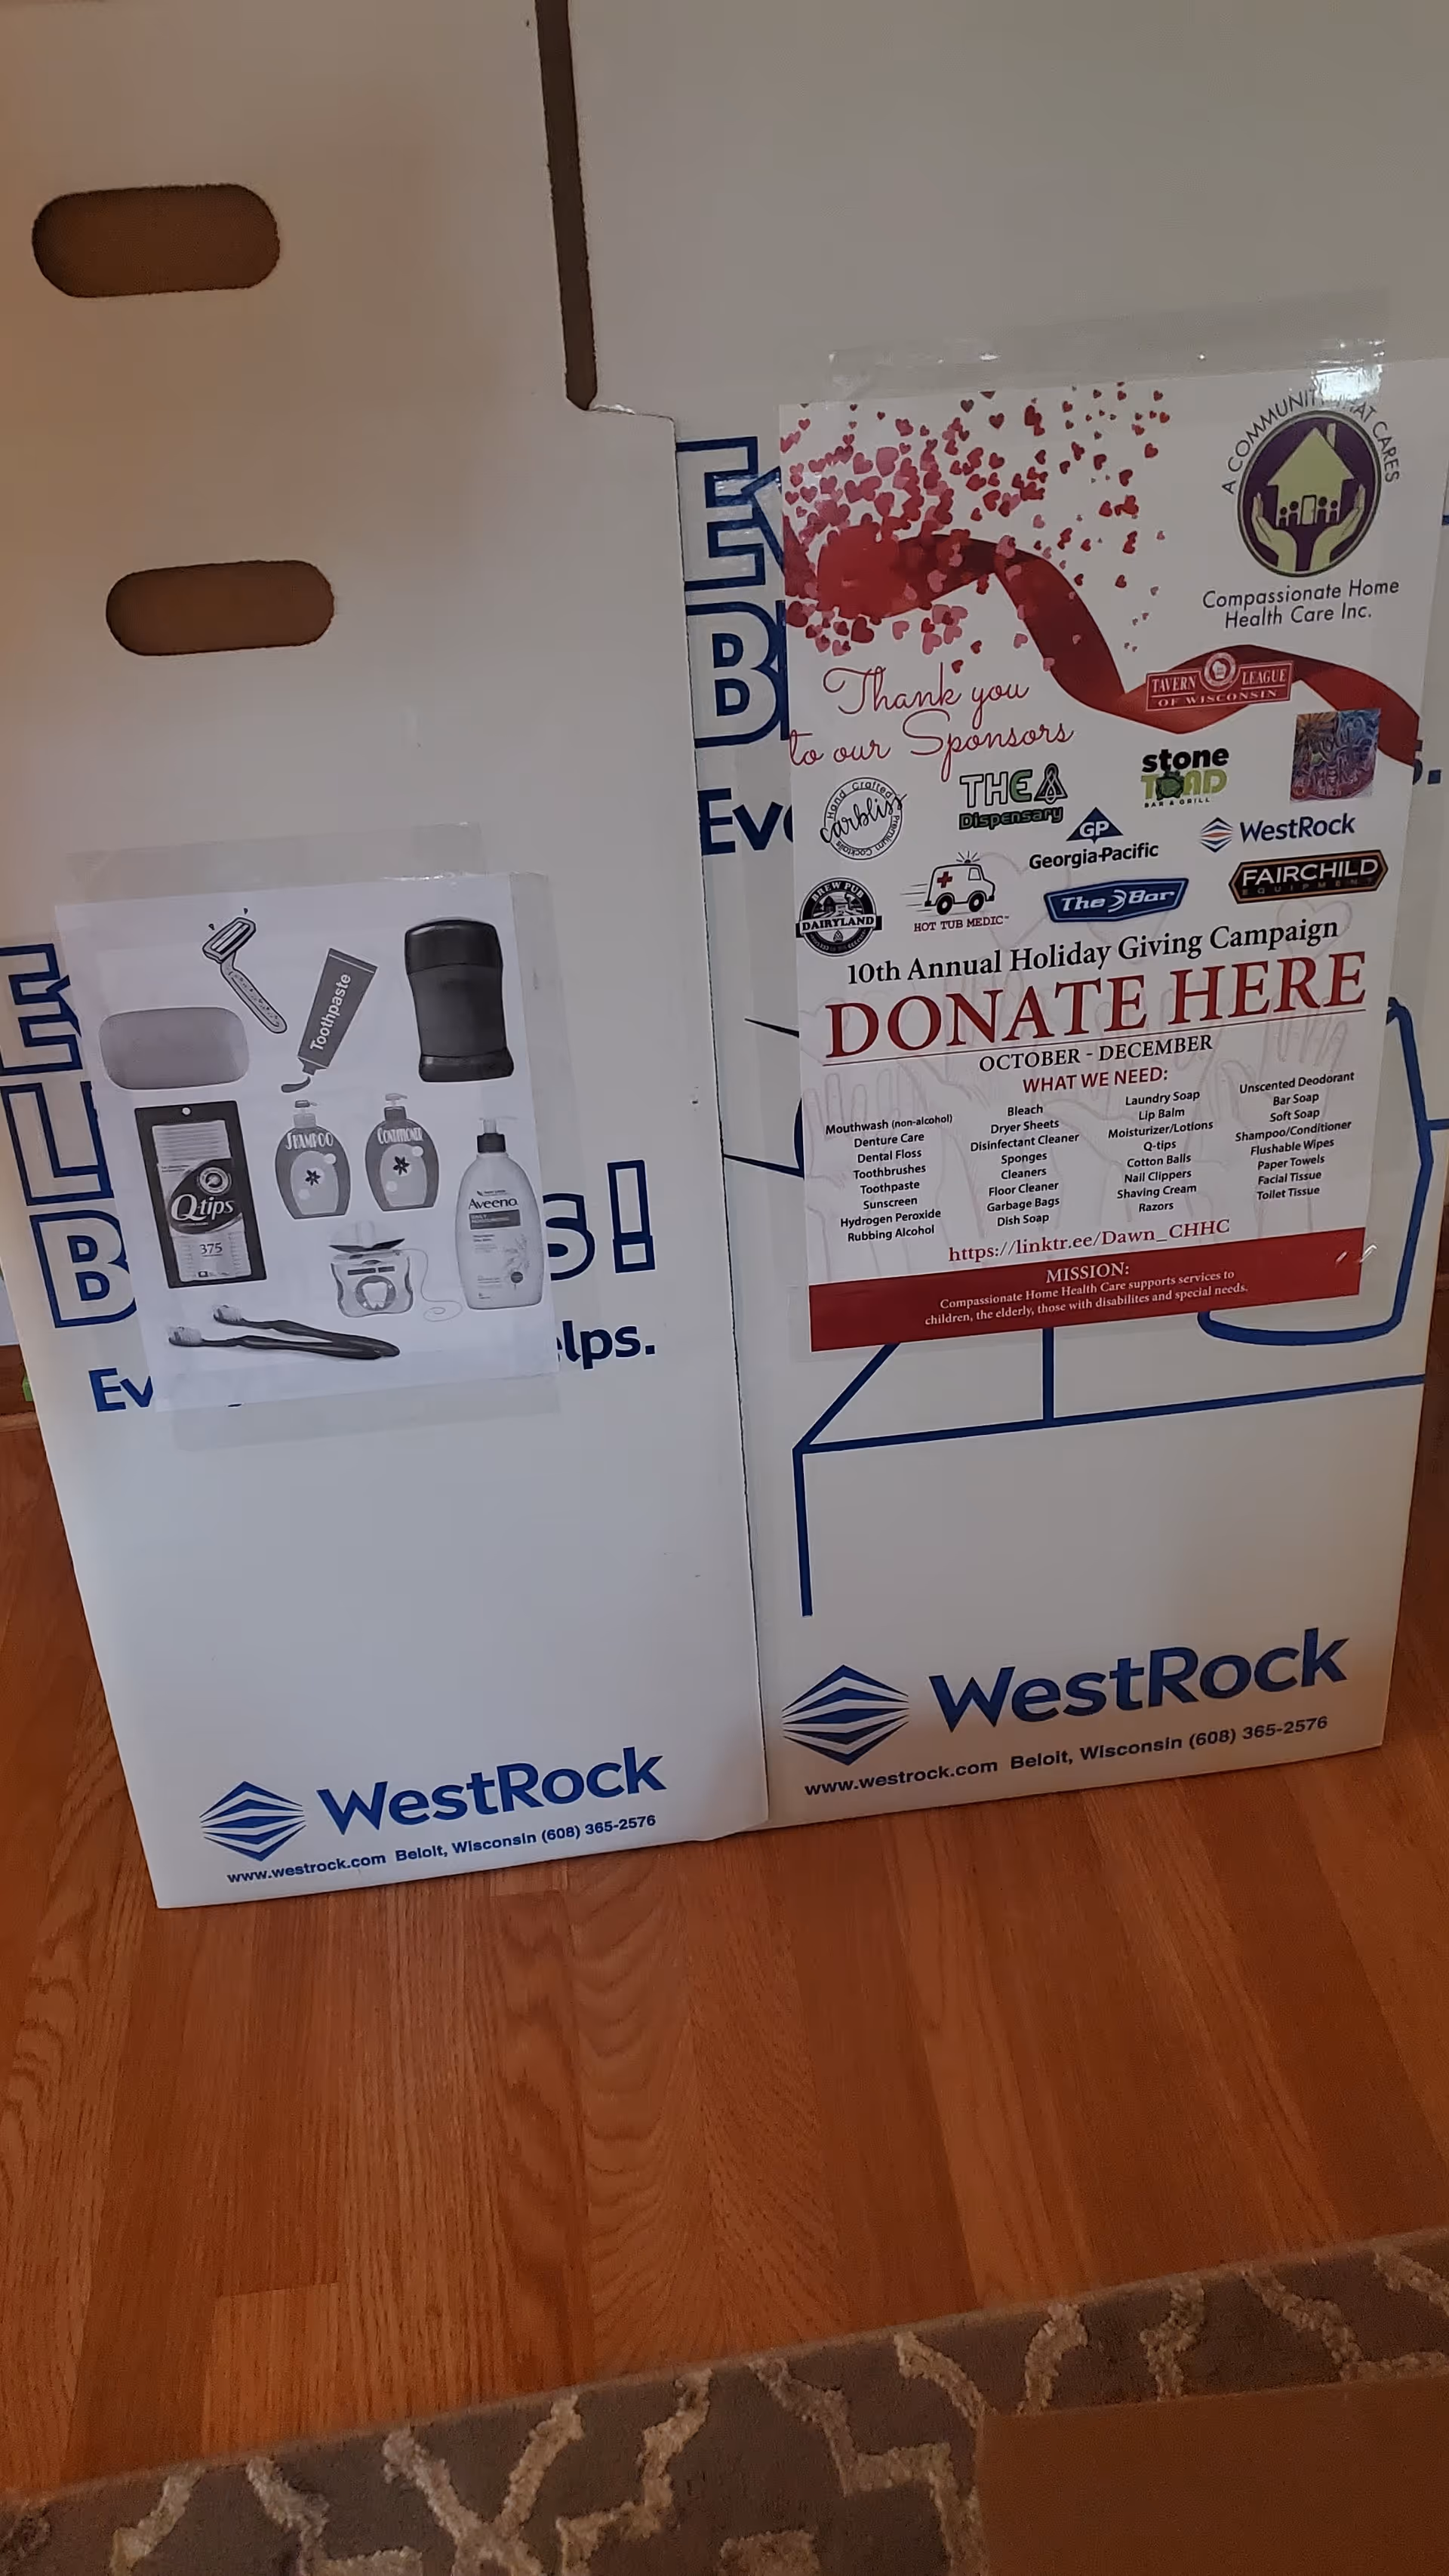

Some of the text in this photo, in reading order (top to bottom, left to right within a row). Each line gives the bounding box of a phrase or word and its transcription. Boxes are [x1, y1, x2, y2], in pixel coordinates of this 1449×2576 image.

[1222, 480, 1236, 494] A
[1372, 421, 1400, 483] CARES
[1202, 578, 1399, 611] Compassionate Home
[1226, 602, 1372, 629] Health Care Inc.
[1152, 676, 1197, 693] TAVERN
[1242, 669, 1287, 685] LEAGUE
[823, 662, 1029, 730] Thank you
[1158, 690, 1276, 706] OF WISCONSIN
[789, 708, 1075, 782] to our Sponsors
[1142, 748, 1229, 773] stone
[827, 781, 893, 819] Hand Crafted
[958, 807, 1063, 830] Dispensary
[875, 815, 900, 851] Premium
[1079, 820, 1109, 838] GP
[1239, 813, 1356, 843] WestRock
[836, 841, 872, 856] Cocktails
[1029, 842, 1158, 869] Georgia-Pacific
[1243, 859, 1378, 886] FAIRCHILD
[811, 882, 864, 901] BREW PUB
[1060, 890, 1175, 912] The Bar
[802, 917, 874, 930] DAIRYLAND
[913, 922, 937, 932] HOT
[940, 919, 963, 930] TUB
[848, 919, 1338, 984] 10th Annual Holiday Giving Campaign
[309, 973, 352, 1051] Toothpaste
[826, 952, 1365, 1058] DONATE HERE
[979, 1048, 1081, 1073] OCTOBER
[1098, 1035, 1213, 1061] DECEMBER
[1023, 1066, 1168, 1094] WHAT WE NEED:
[1240, 1072, 1355, 1094] Unscented Deodorant
[1125, 1091, 1200, 1106] Laundry Soap
[1273, 1094, 1319, 1106] Bar Soap
[1008, 1104, 1044, 1116] Bleach
[1139, 1108, 1185, 1122] Lip Balm
[1269, 1109, 1320, 1122] Soft Soap
[826, 1114, 952, 1134] Mouthwash (non-alcohol)
[991, 1120, 1060, 1135] Dryer Sheets
[1108, 1121, 1214, 1139] Moisturizer/Lotions
[1235, 1122, 1352, 1142] Shampoo/Conditioner
[854, 1133, 924, 1147] Denture Care
[971, 1134, 1079, 1152] Disinfectant Cleaner
[1143, 1140, 1177, 1151] Q-tips
[1251, 1138, 1334, 1156] Flushable Wipes
[857, 1149, 921, 1163] Dental Floss
[1001, 1152, 1048, 1166] Sponges
[1127, 1153, 1192, 1168] Cotton Balls
[1257, 1154, 1325, 1171] Paper Towels
[854, 1164, 926, 1180] Toothbrushes
[1001, 1168, 1047, 1180] Cleaners
[1124, 1170, 1192, 1183] Nail Clippers
[1258, 1171, 1321, 1185] Facial Tissue
[860, 1180, 920, 1194] Toothpaste
[989, 1182, 1059, 1196] Floor Cleaner
[1117, 1184, 1197, 1199] Shaving Cream
[1257, 1186, 1320, 1200] Toilet Tissue
[469, 1198, 518, 1210] Aveeno
[863, 1196, 918, 1210] Sunscreen
[987, 1196, 1060, 1212] Garbage Bags
[1139, 1202, 1174, 1213] Razors
[841, 1208, 941, 1229] Hydrogen Peroxide
[997, 1213, 1049, 1226] Dish Soap
[848, 1224, 935, 1242] Rubbing Alcohol
[199, 1242, 223, 1255] 375
[1046, 1262, 1130, 1284] MISSION:
[940, 1271, 1235, 1310] Compassionate Home Health Care supports services to
[925, 1282, 1248, 1325] children, the elderly, those with disabilites and special needs.
[928, 1627, 1349, 1734] WestRock
[804, 1716, 1328, 1796] www.westrock.com Beloit, Wisconsin (608) 365-2576
[315, 1746, 668, 1836] WestRock
[227, 1814, 656, 1883] www.westrock.com Beloit, Wisconsin (608) 365-2576
